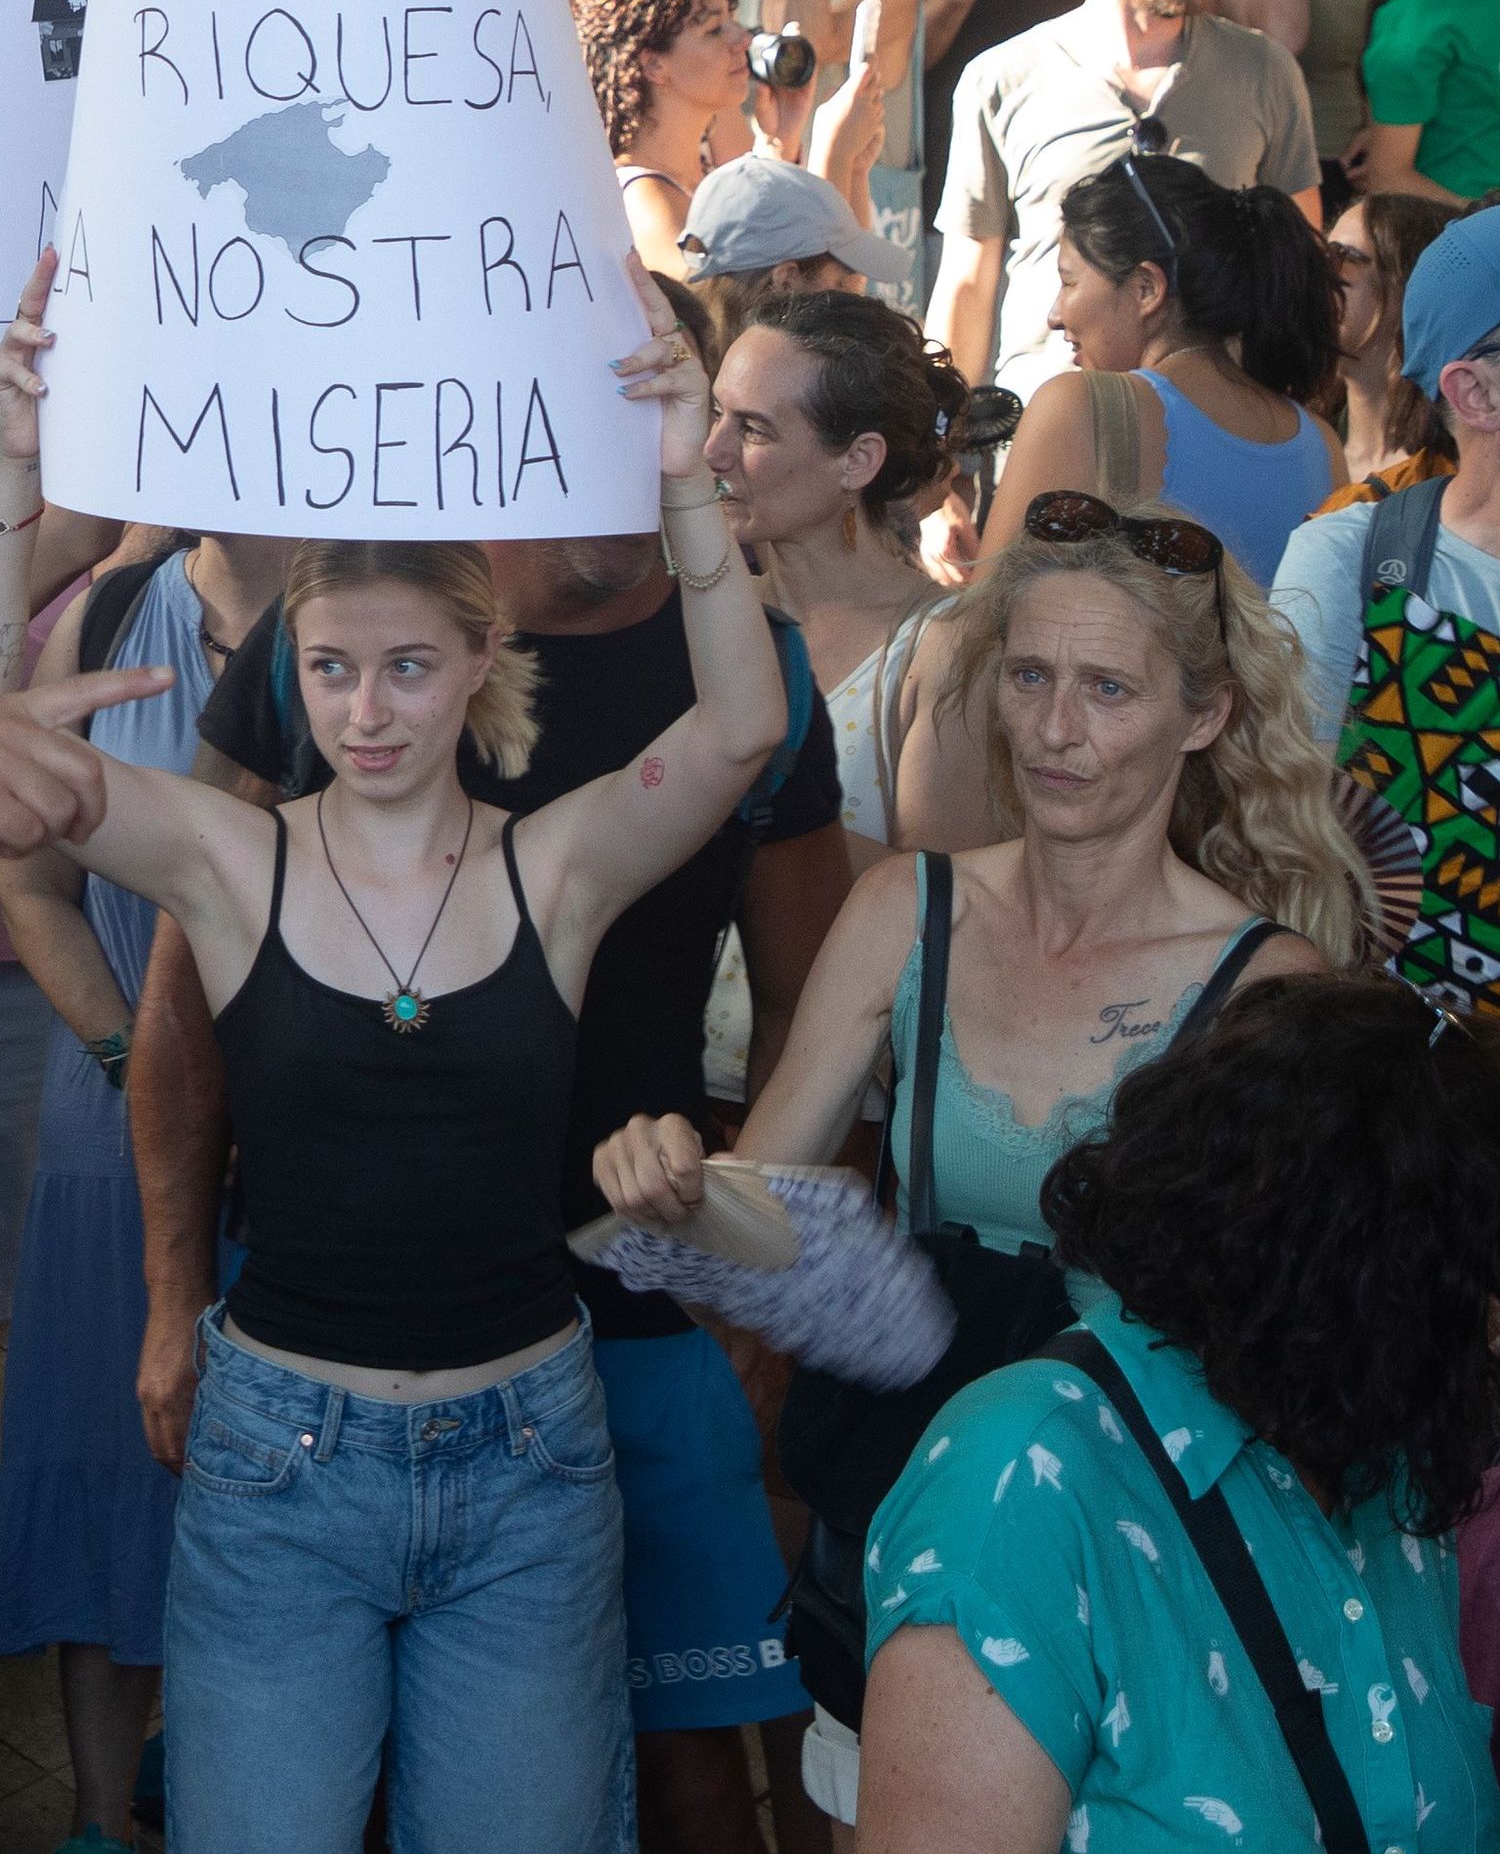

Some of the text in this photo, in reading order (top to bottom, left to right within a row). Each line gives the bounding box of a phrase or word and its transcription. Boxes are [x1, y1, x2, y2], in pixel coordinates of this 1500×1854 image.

[133, 7, 552, 114] RIQUESA,
[151, 208, 594, 328] NOSTRA
[136, 377, 569, 511] MISERIA
[653, 1644, 758, 1684] BOSS
